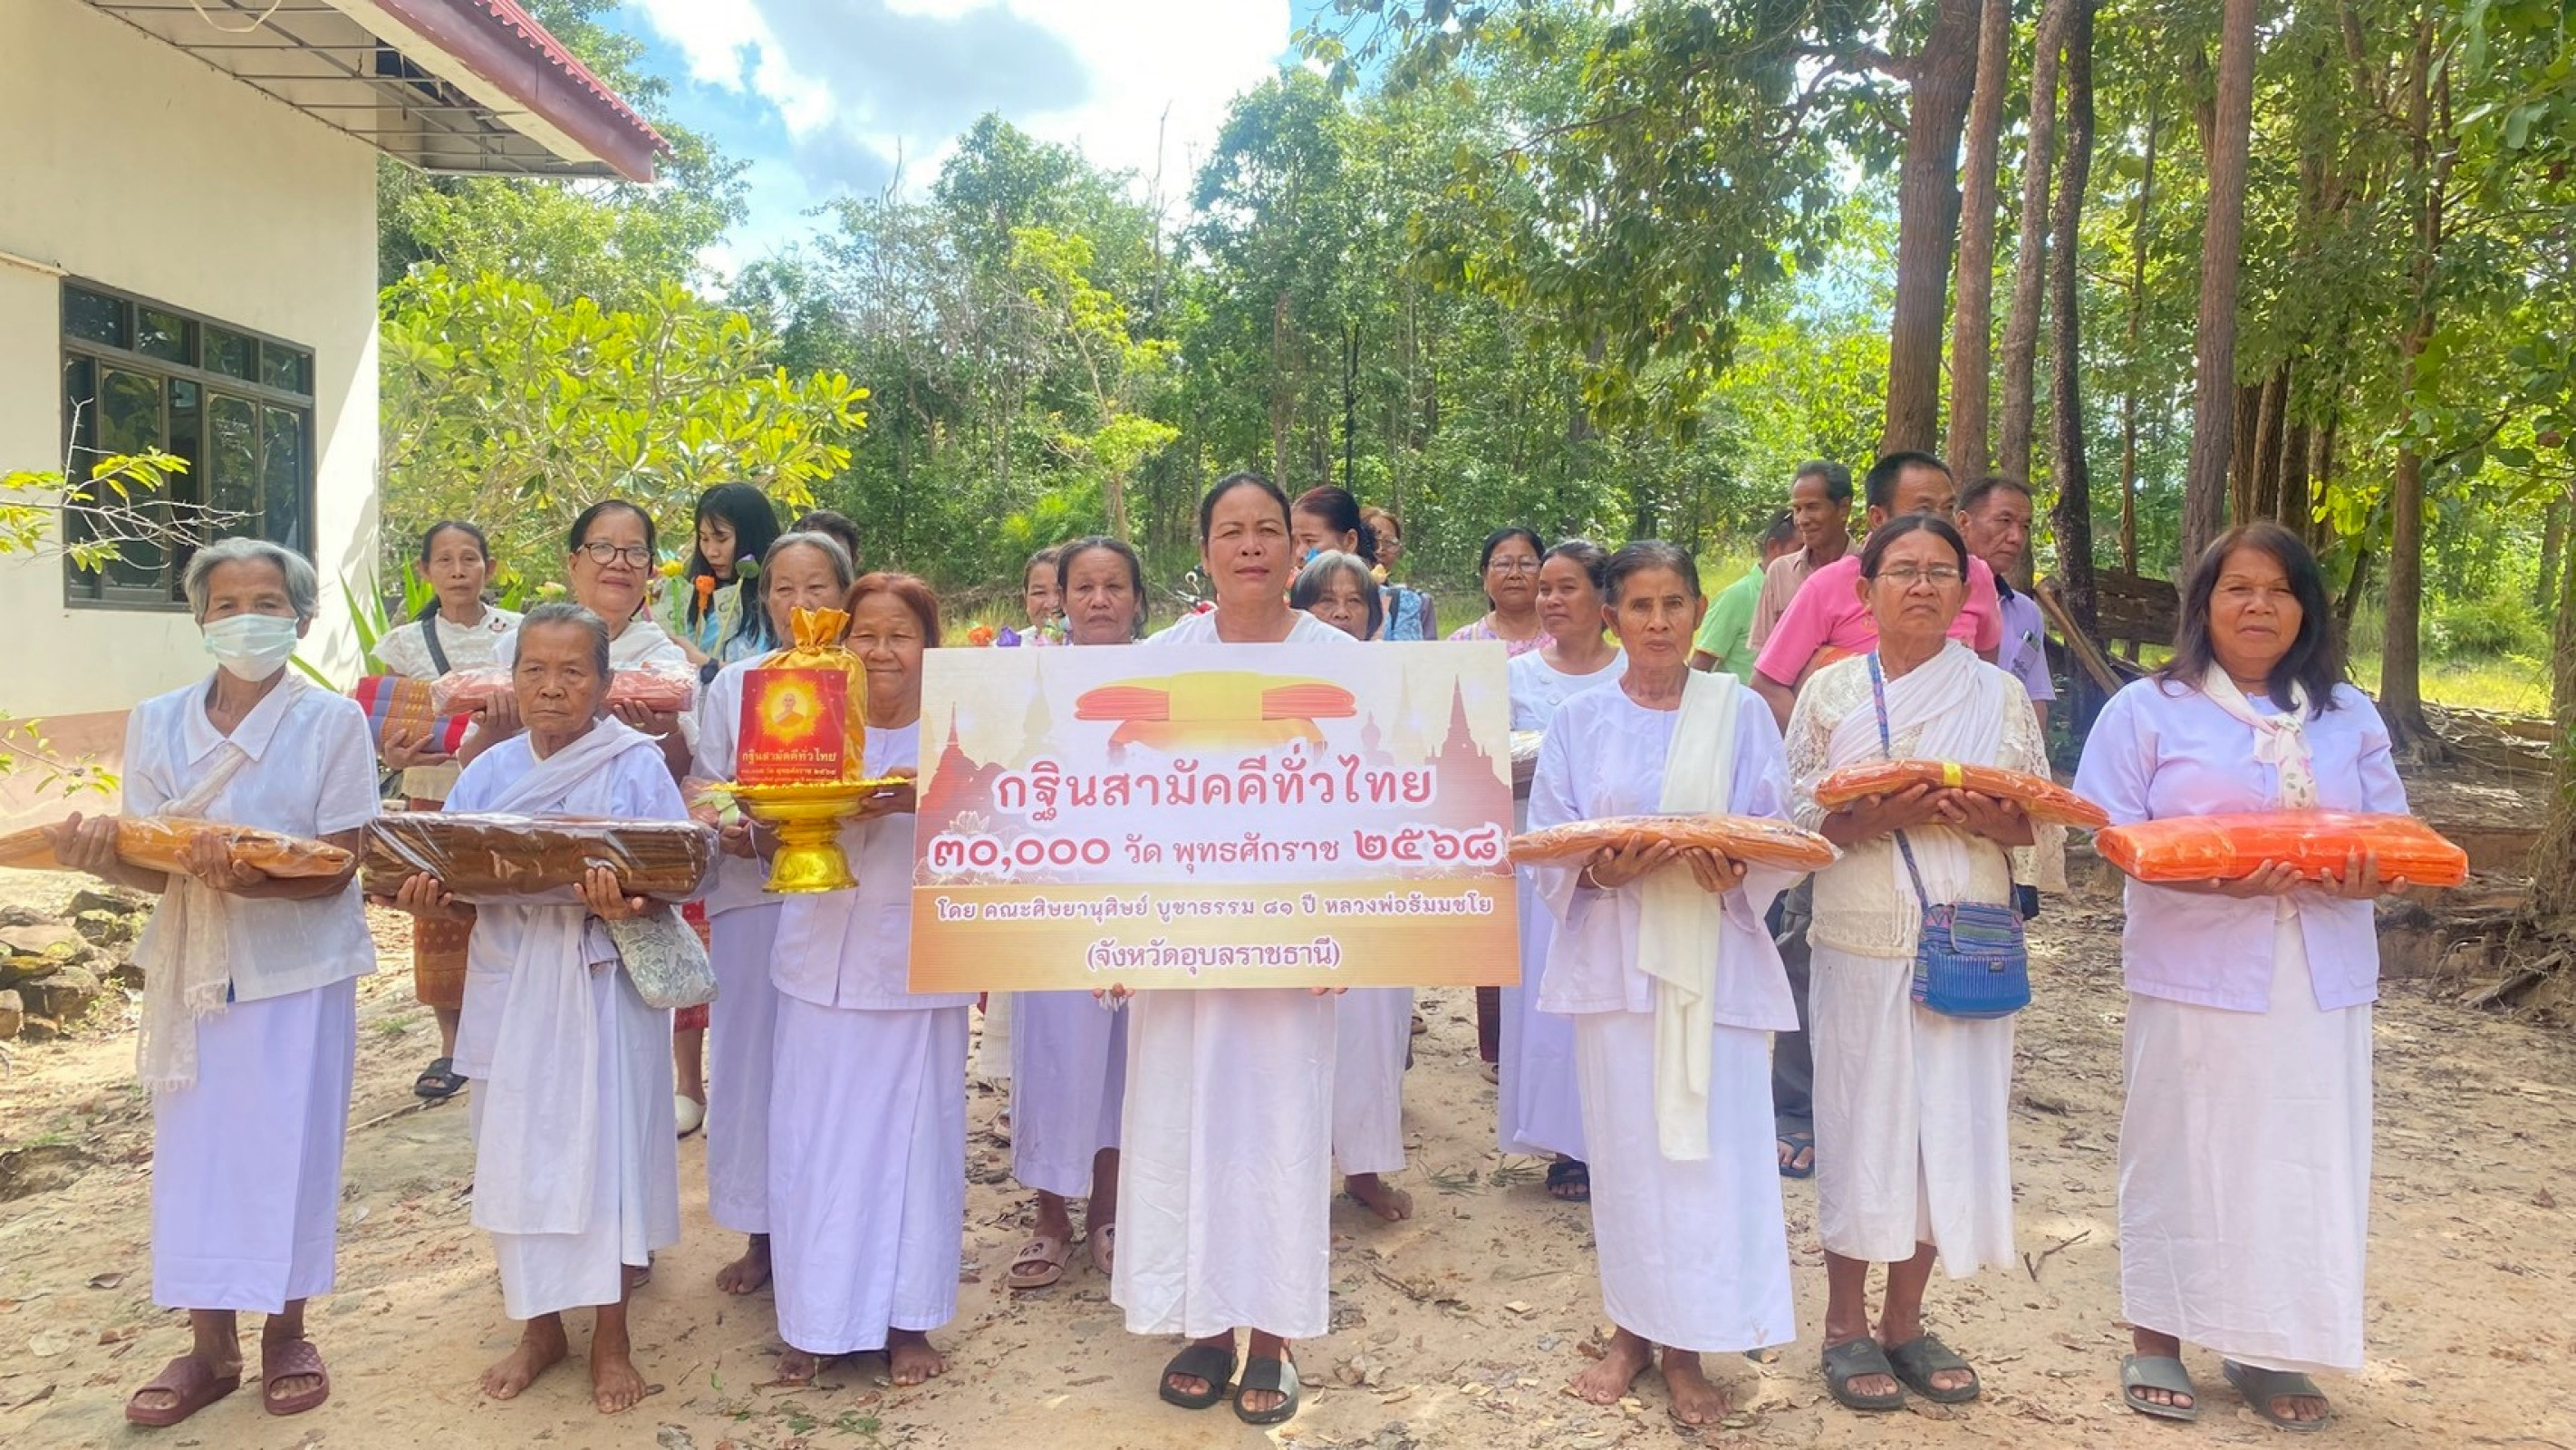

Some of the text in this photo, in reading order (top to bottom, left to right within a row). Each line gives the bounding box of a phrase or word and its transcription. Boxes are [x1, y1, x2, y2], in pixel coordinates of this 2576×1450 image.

[999, 743, 1431, 821] กฐินสามัคคีทั่วไทย
[934, 828, 1497, 875] ๓๐,๐๐๐ วัด พุทธศักราช ๒๕๖๘
[937, 893, 1492, 923] โดย คณะศิษยานุศิษย์ บูชาธรรม ๘๑ ปี หลวงพ่อธัมมชโย
[1086, 937, 1341, 974] (จังหวัดอุบลราชธานี)
